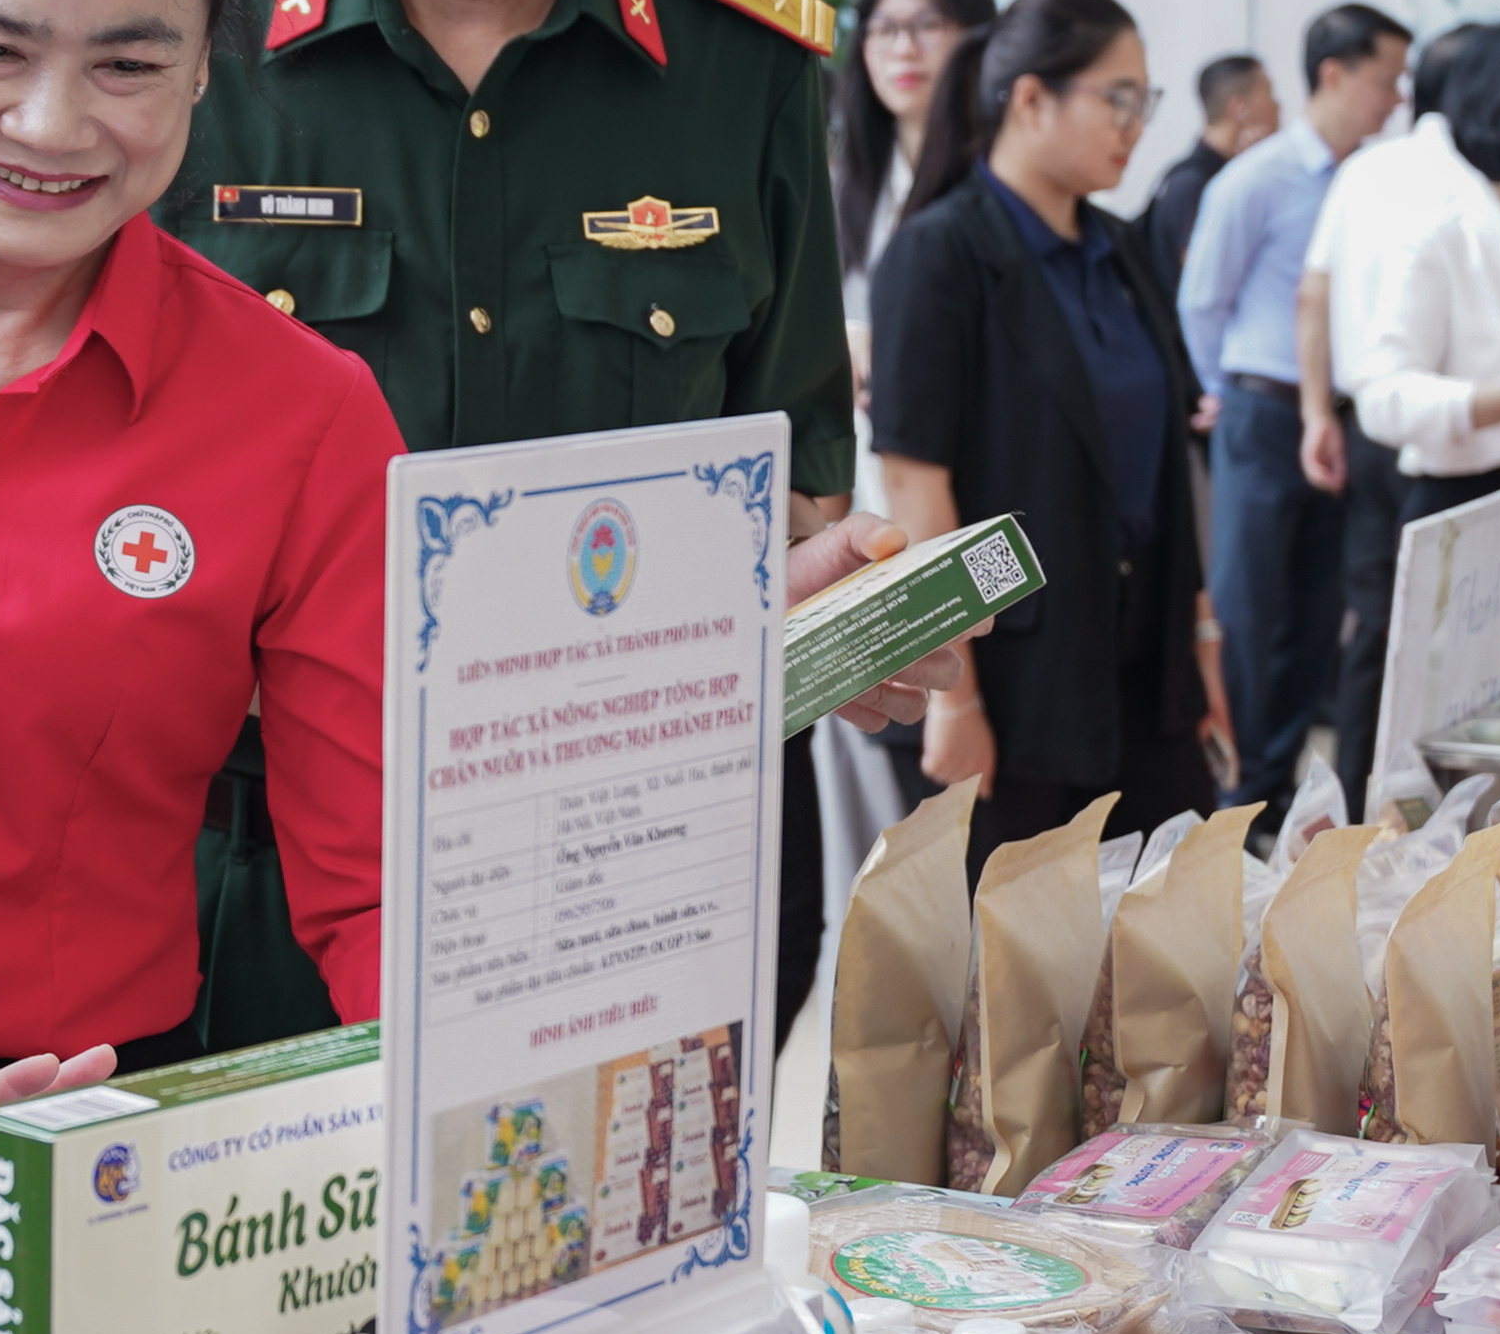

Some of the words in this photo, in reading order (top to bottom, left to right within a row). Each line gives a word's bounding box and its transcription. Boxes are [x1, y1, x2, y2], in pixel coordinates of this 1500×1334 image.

[167, 1144, 221, 1172] CÔNG
[222, 1138, 248, 1161] TY
[248, 1122, 274, 1153] CỔ
[276, 1111, 325, 1147] PHẦN
[328, 1104, 364, 1133] SẢN
[175, 1190, 306, 1279] Bánh
[317, 1166, 378, 1240] Sữ
